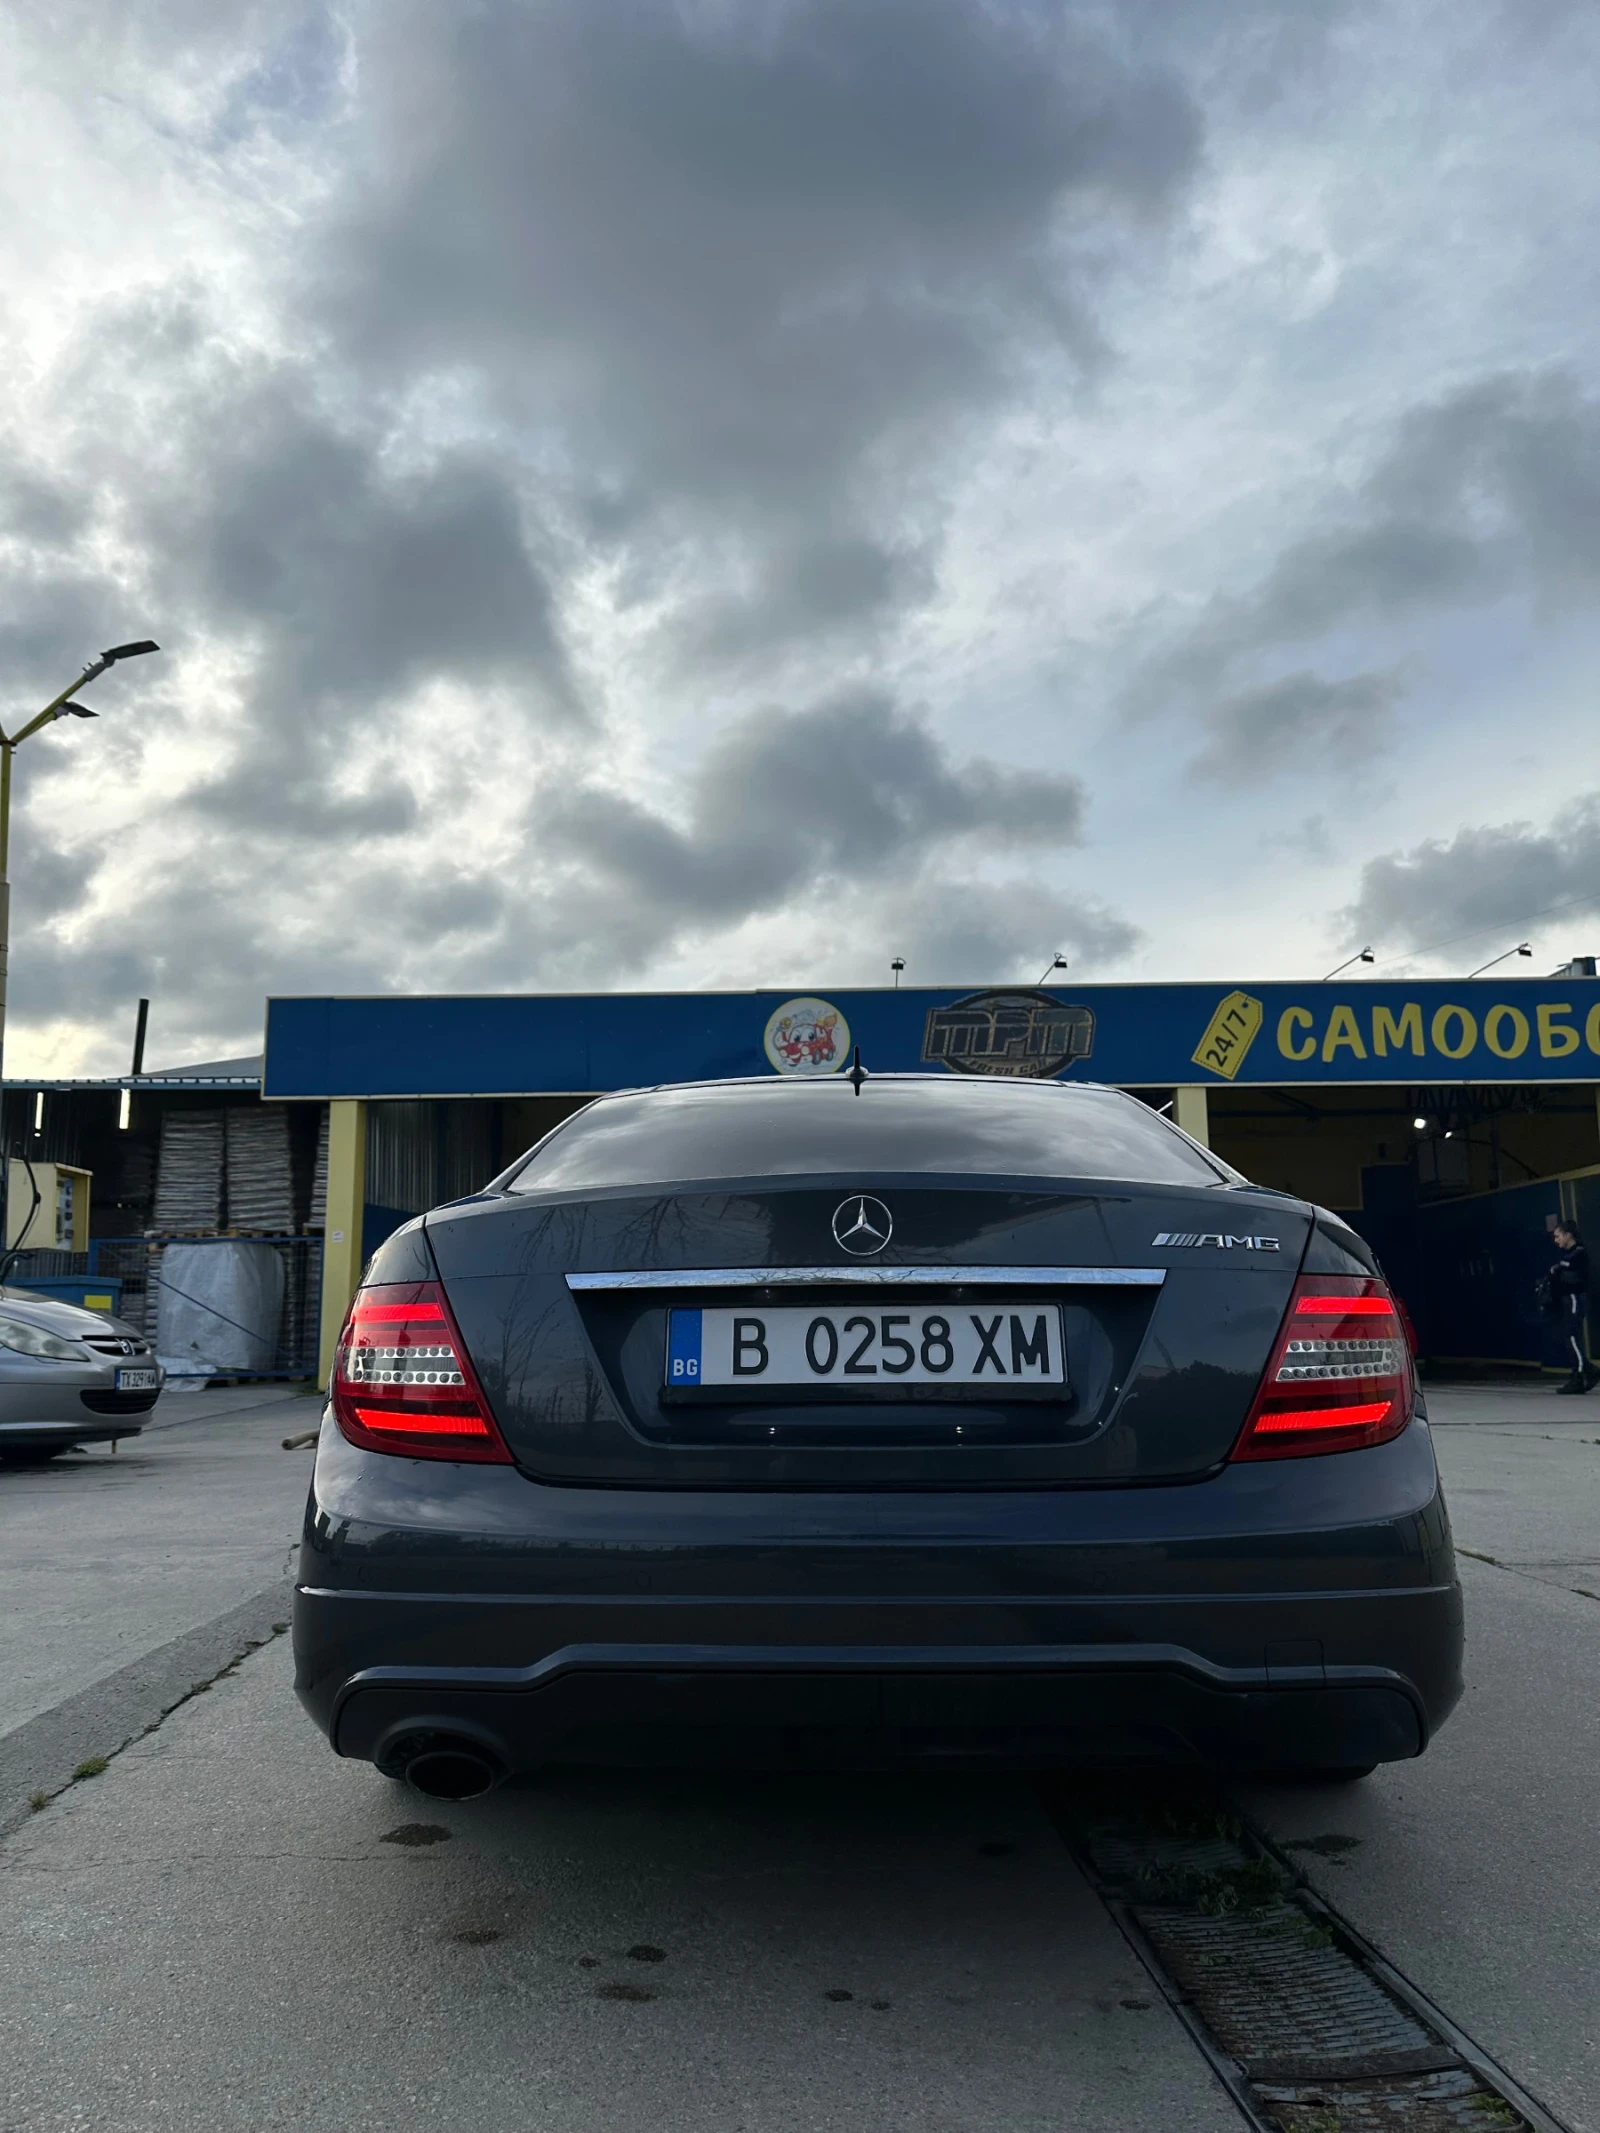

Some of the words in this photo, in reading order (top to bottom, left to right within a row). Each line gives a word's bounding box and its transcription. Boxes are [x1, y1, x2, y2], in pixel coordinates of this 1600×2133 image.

[1206, 1009, 1247, 1067] 24/7
[1194, 1233, 1280, 1252] AMG
[732, 1318, 768, 1376] B
[805, 1316, 954, 1375] 0258
[969, 1315, 1050, 1374] XM
[673, 1358, 698, 1376] BG
